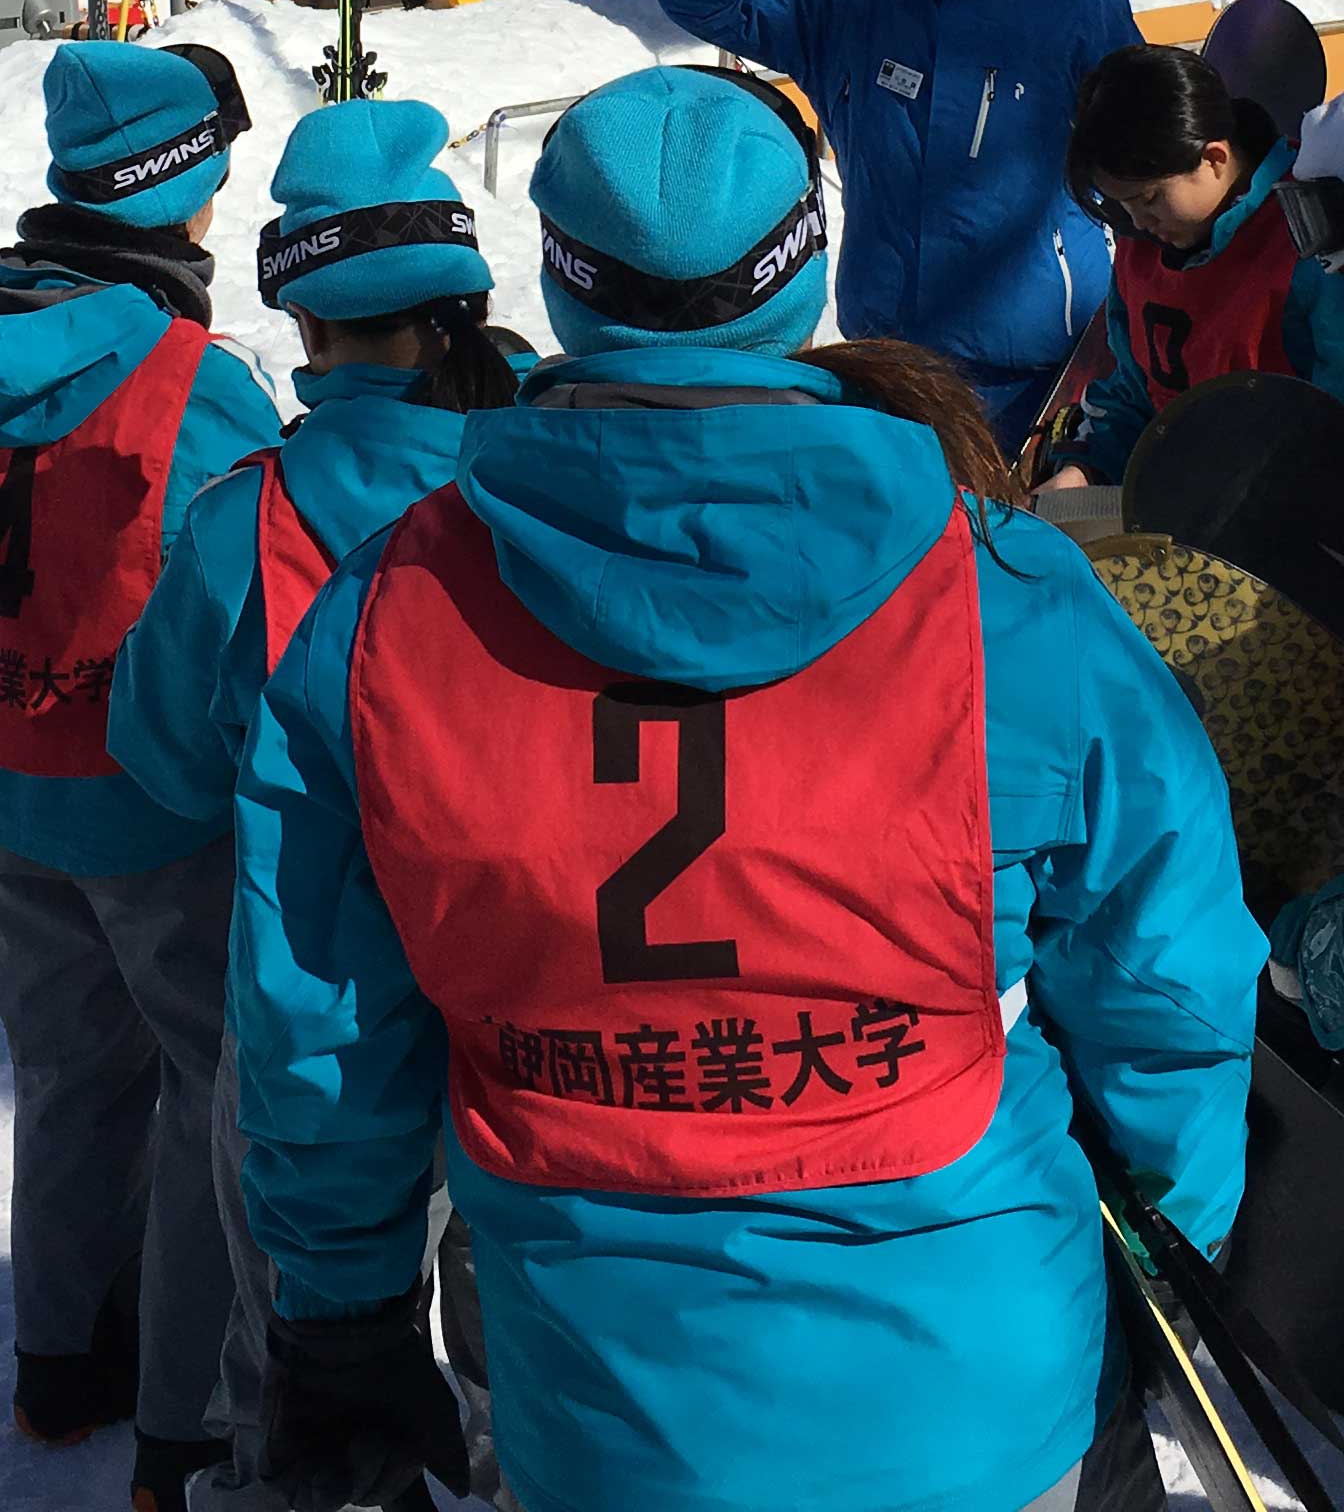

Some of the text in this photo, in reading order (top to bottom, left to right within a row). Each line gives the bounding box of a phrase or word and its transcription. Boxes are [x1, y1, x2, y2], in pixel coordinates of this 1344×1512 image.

[114, 128, 216, 189] SWANS
[262, 226, 342, 280] SWANS
[593, 682, 740, 984] 2
[482, 996, 926, 1114] 静岡産業大学
